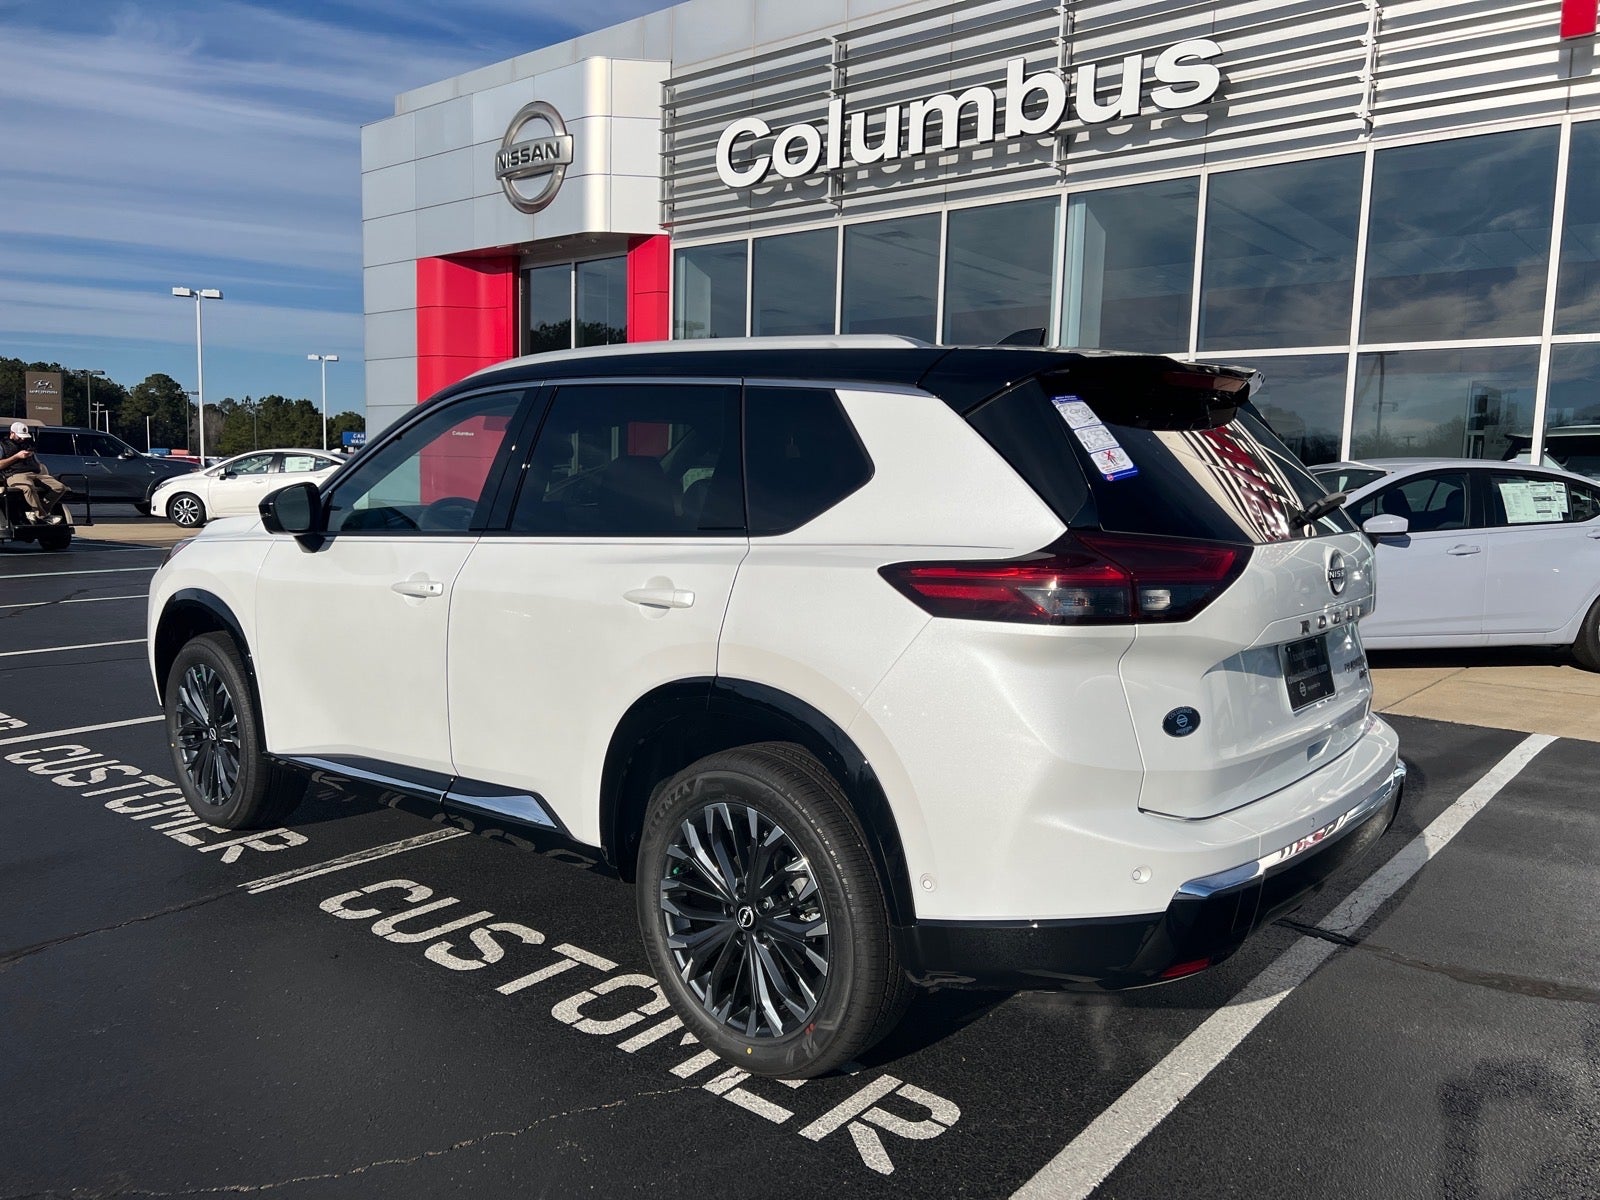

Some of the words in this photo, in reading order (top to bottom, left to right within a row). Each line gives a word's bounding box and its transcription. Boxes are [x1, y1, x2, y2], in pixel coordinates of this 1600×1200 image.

[498, 141, 560, 172] NISSAN
[715, 38, 1223, 189] Columbus
[4, 744, 309, 864] CUSTOMER
